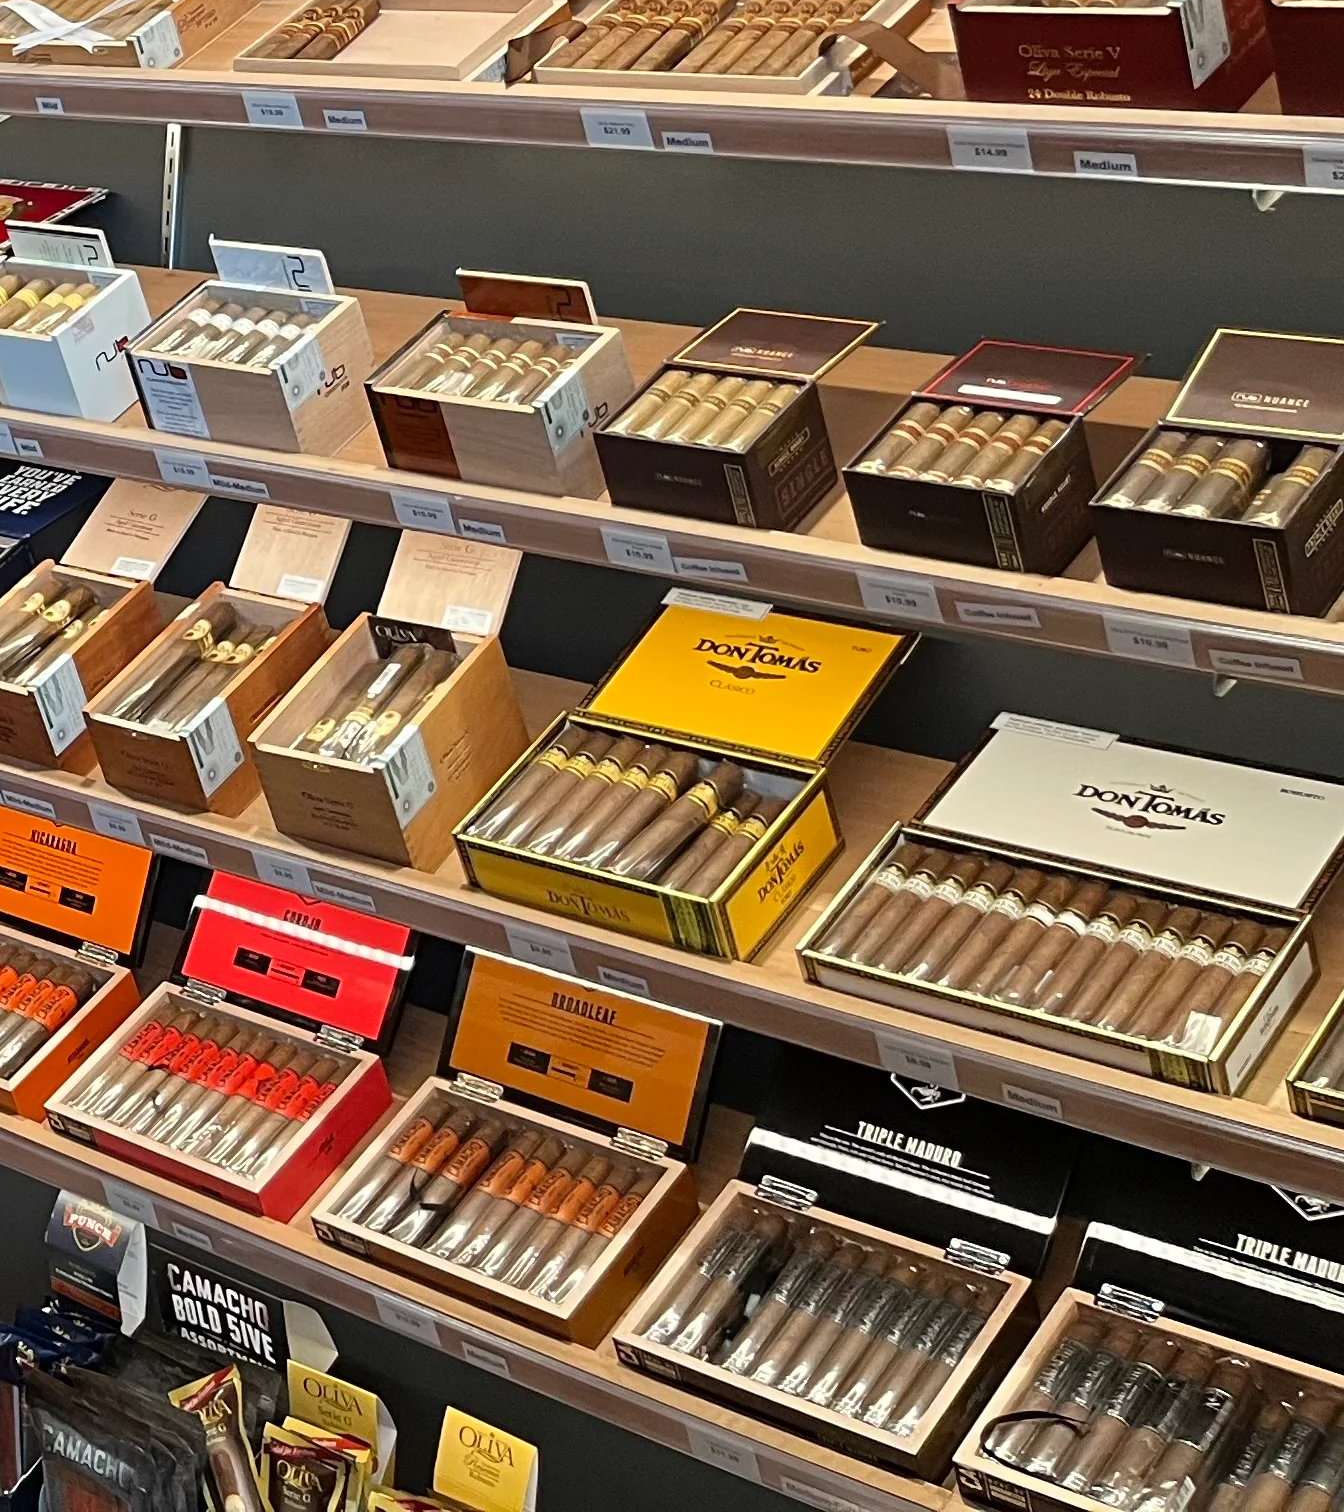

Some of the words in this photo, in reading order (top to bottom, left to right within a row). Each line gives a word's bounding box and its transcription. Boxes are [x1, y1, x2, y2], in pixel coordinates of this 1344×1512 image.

[1018, 44, 1060, 58] Oliva
[1106, 47, 1120, 59] V
[328, 115, 363, 126] Medium
[666, 135, 709, 148] Medium
[1080, 159, 1132, 172] Medium
[1263, 393, 1310, 409] NUANCE
[0, 474, 68, 494] EARNED
[14, 465, 82, 485] YOU'VE
[462, 524, 502, 538] Medium
[693, 638, 749, 661] DON
[744, 641, 822, 675] TOMÁS
[1072, 783, 1142, 809] DON
[1136, 789, 1226, 828] TOMÁS
[30, 829, 78, 856] NICARAGUA
[547, 889, 584, 909] DON
[283, 909, 322, 930] COROJO
[551, 992, 617, 1025] BROADLEAF
[857, 1121, 904, 1150] TRIPLE
[907, 1136, 963, 1169] MADURO
[68, 1213, 113, 1240] PUNCH
[1237, 1234, 1292, 1265] TRIPLE
[1293, 1246, 1344, 1284] MADU
[167, 1263, 270, 1332] CAMACHO
[171, 1293, 222, 1335] BOLD
[303, 1377, 363, 1417] OLIVA
[459, 1425, 515, 1469] OLIVA
